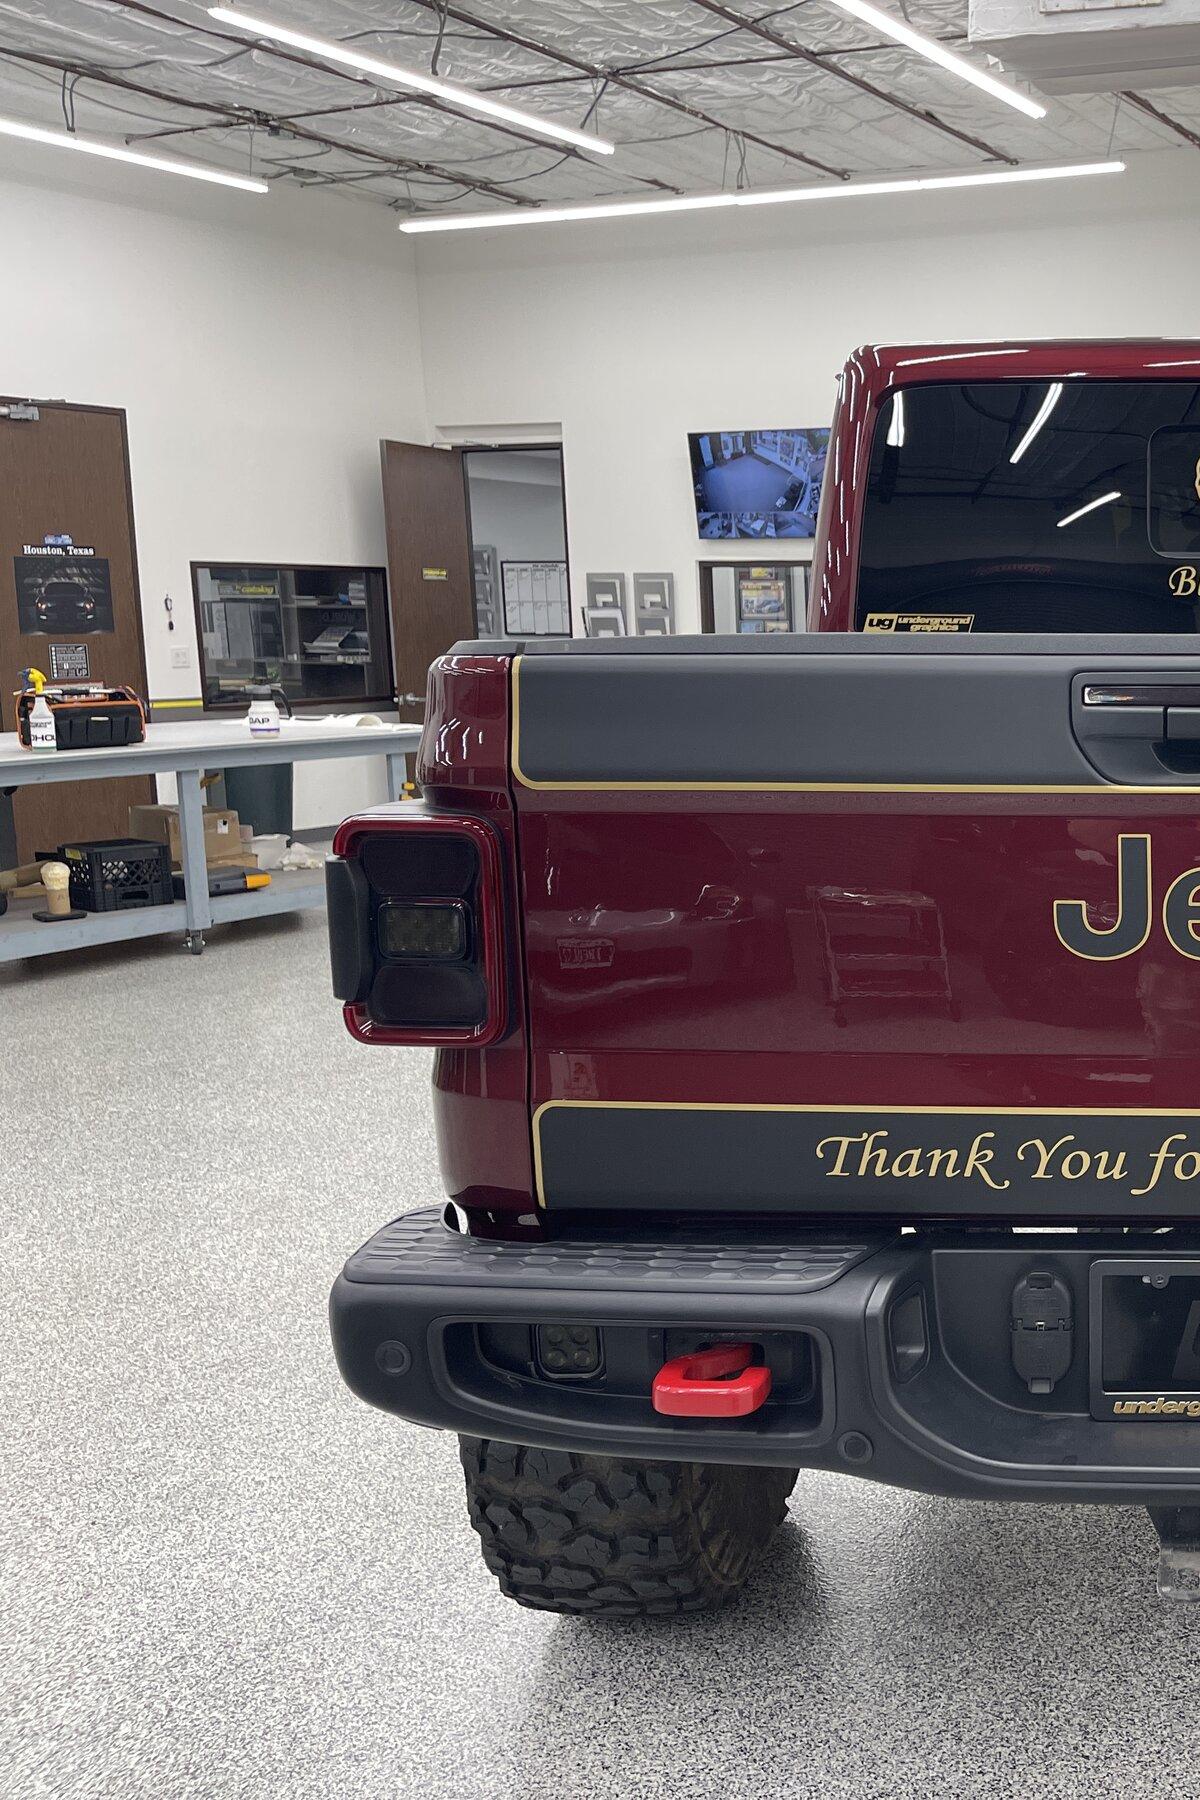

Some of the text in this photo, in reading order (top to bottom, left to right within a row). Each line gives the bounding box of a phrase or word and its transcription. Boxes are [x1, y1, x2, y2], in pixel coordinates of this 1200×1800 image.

[23, 545, 94, 556] Houston, Texas
[868, 617, 893, 630] ug
[897, 616, 971, 625] underground
[909, 624, 960, 632] graphics
[815, 1130, 1010, 1190] Thank
[1017, 1134, 1128, 1180] You
